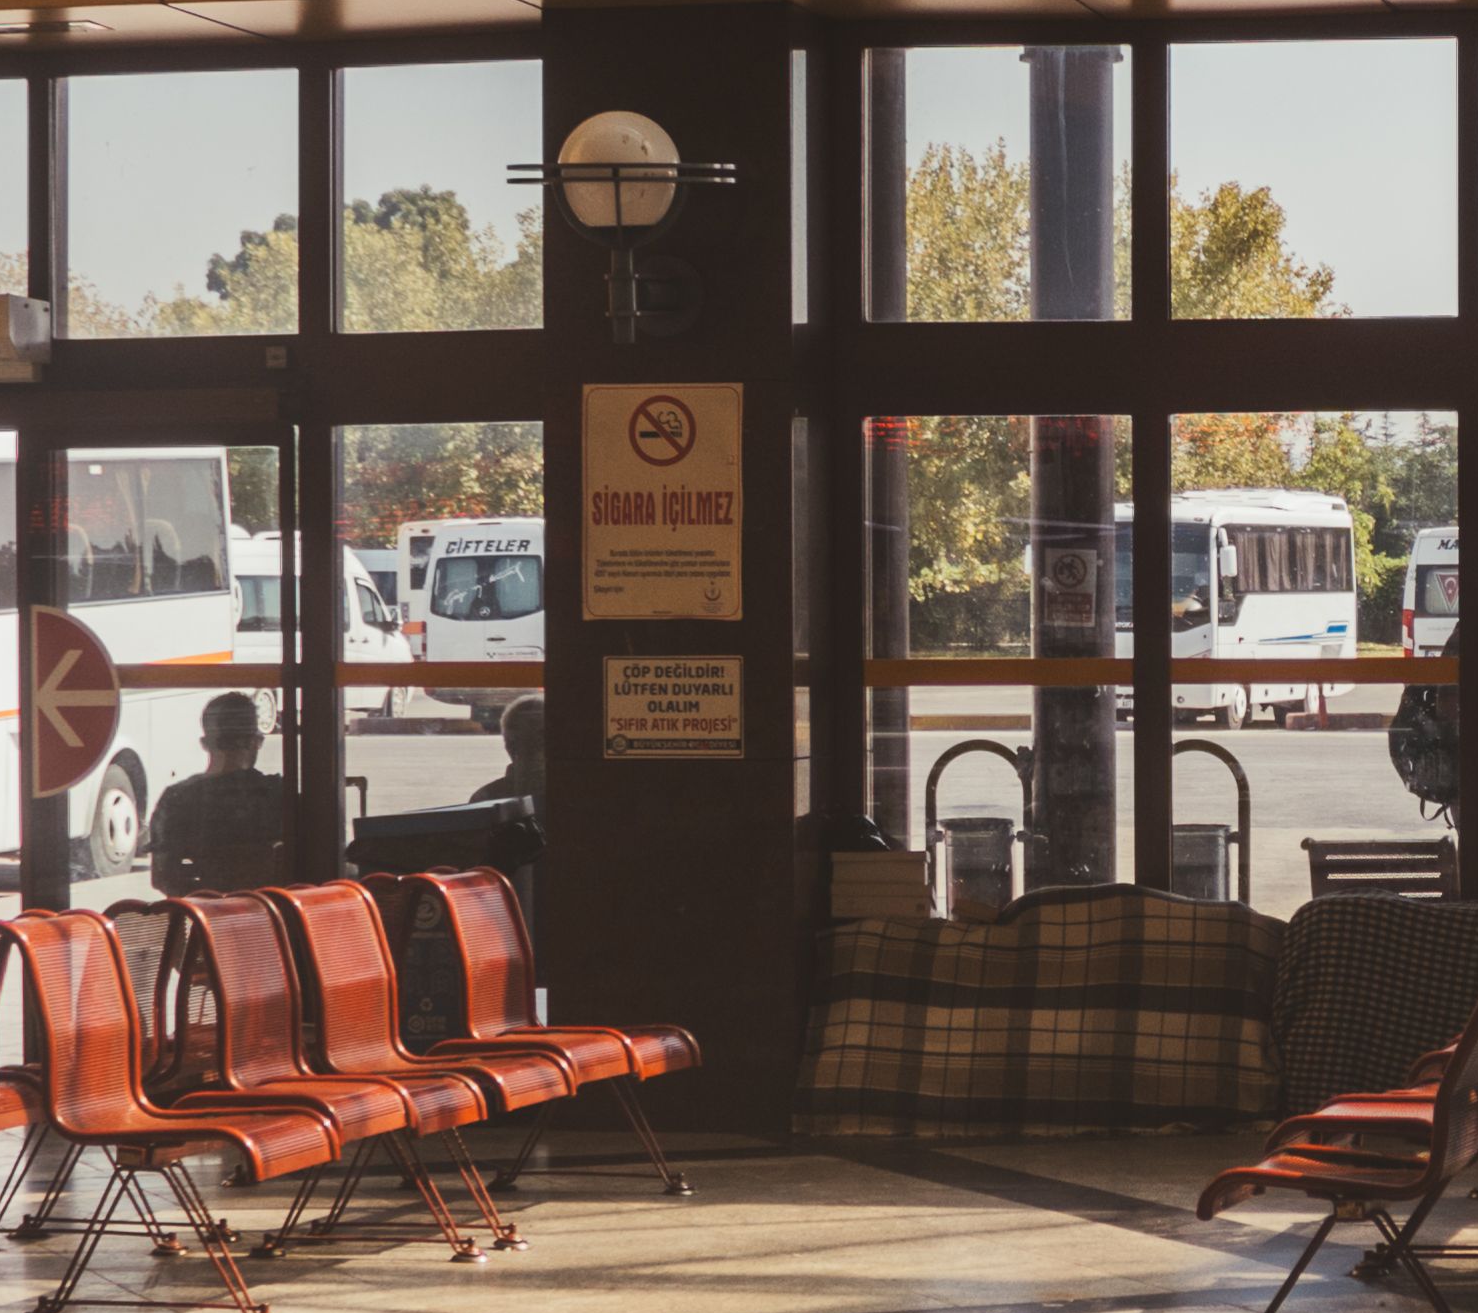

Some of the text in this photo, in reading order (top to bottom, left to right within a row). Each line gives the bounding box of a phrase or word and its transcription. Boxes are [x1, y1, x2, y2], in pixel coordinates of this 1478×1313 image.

[592, 484, 734, 532] SİGARA İÇİLMEZ
[623, 662, 724, 680] ÇÖP DEĞİLDİR!
[614, 680, 733, 696] LÜTFEN DUYARLI
[647, 700, 700, 713] OLALIM
[651, 717, 679, 731] ATIK
